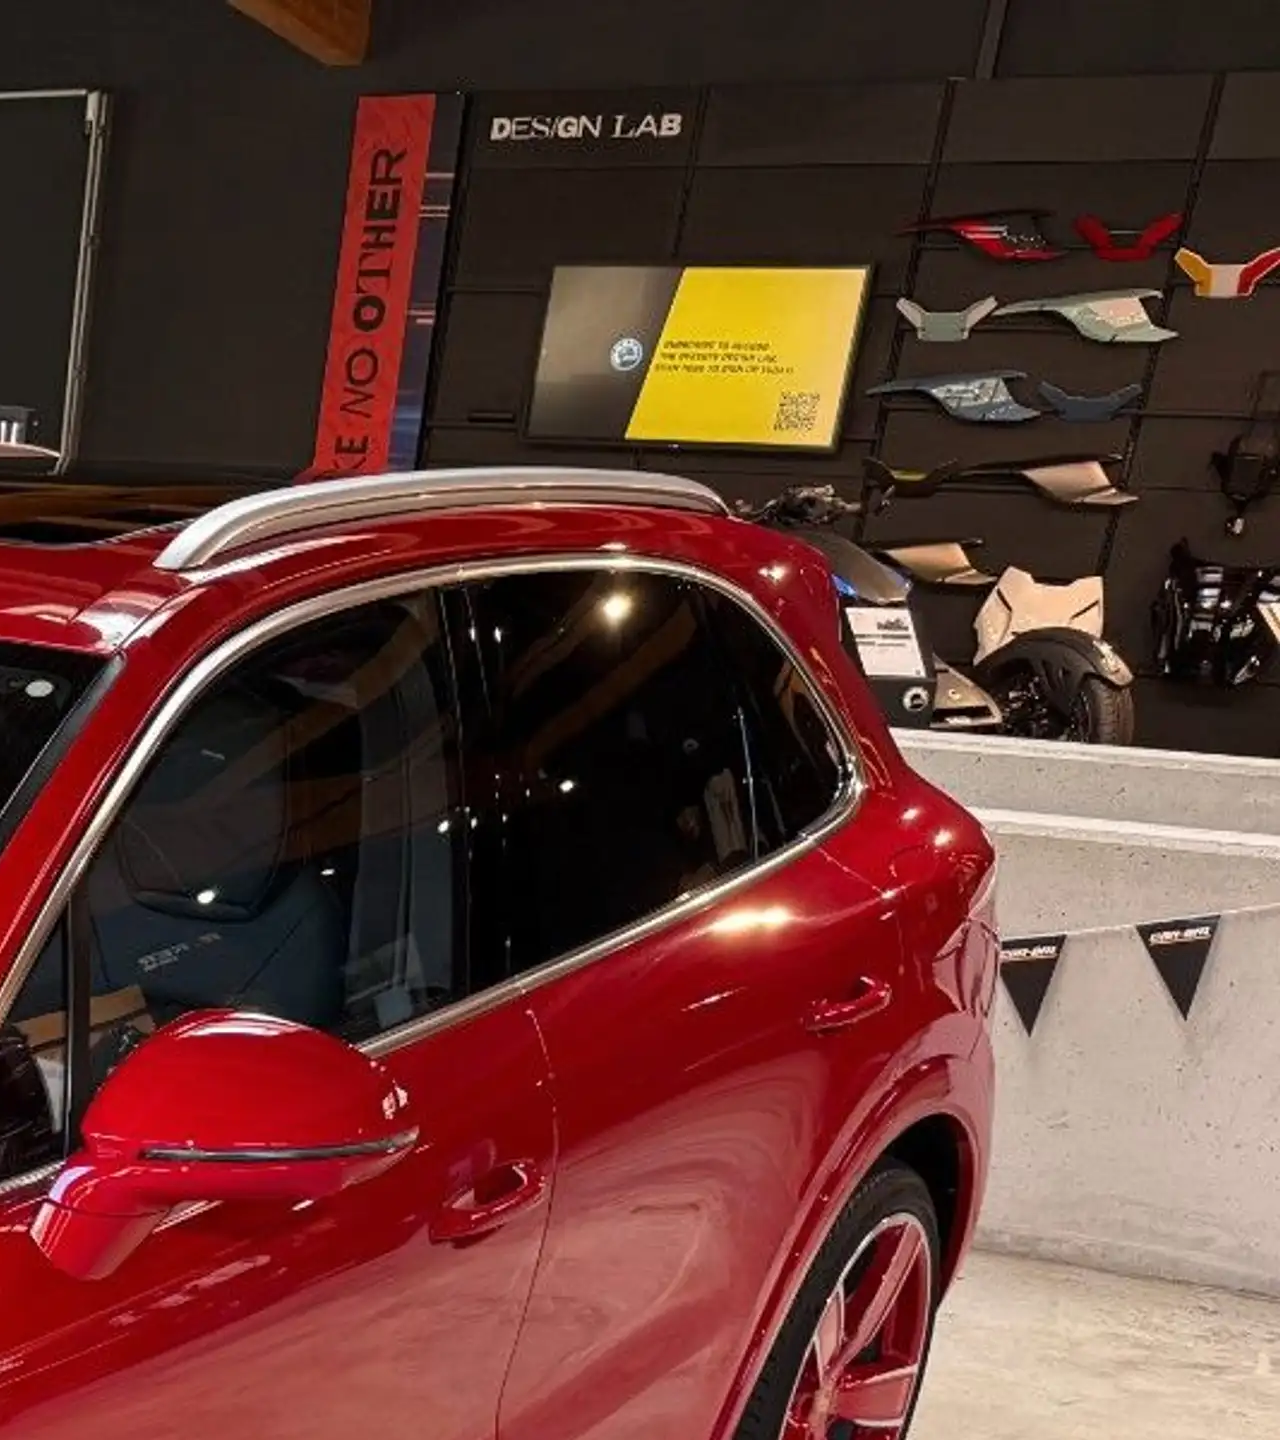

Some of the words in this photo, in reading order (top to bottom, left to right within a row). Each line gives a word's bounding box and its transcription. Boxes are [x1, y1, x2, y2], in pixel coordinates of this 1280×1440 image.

[490, 115, 602, 140] DESIGN
[611, 114, 683, 138] LAB
[353, 148, 407, 332] OTHER
[340, 348, 378, 419] NO
